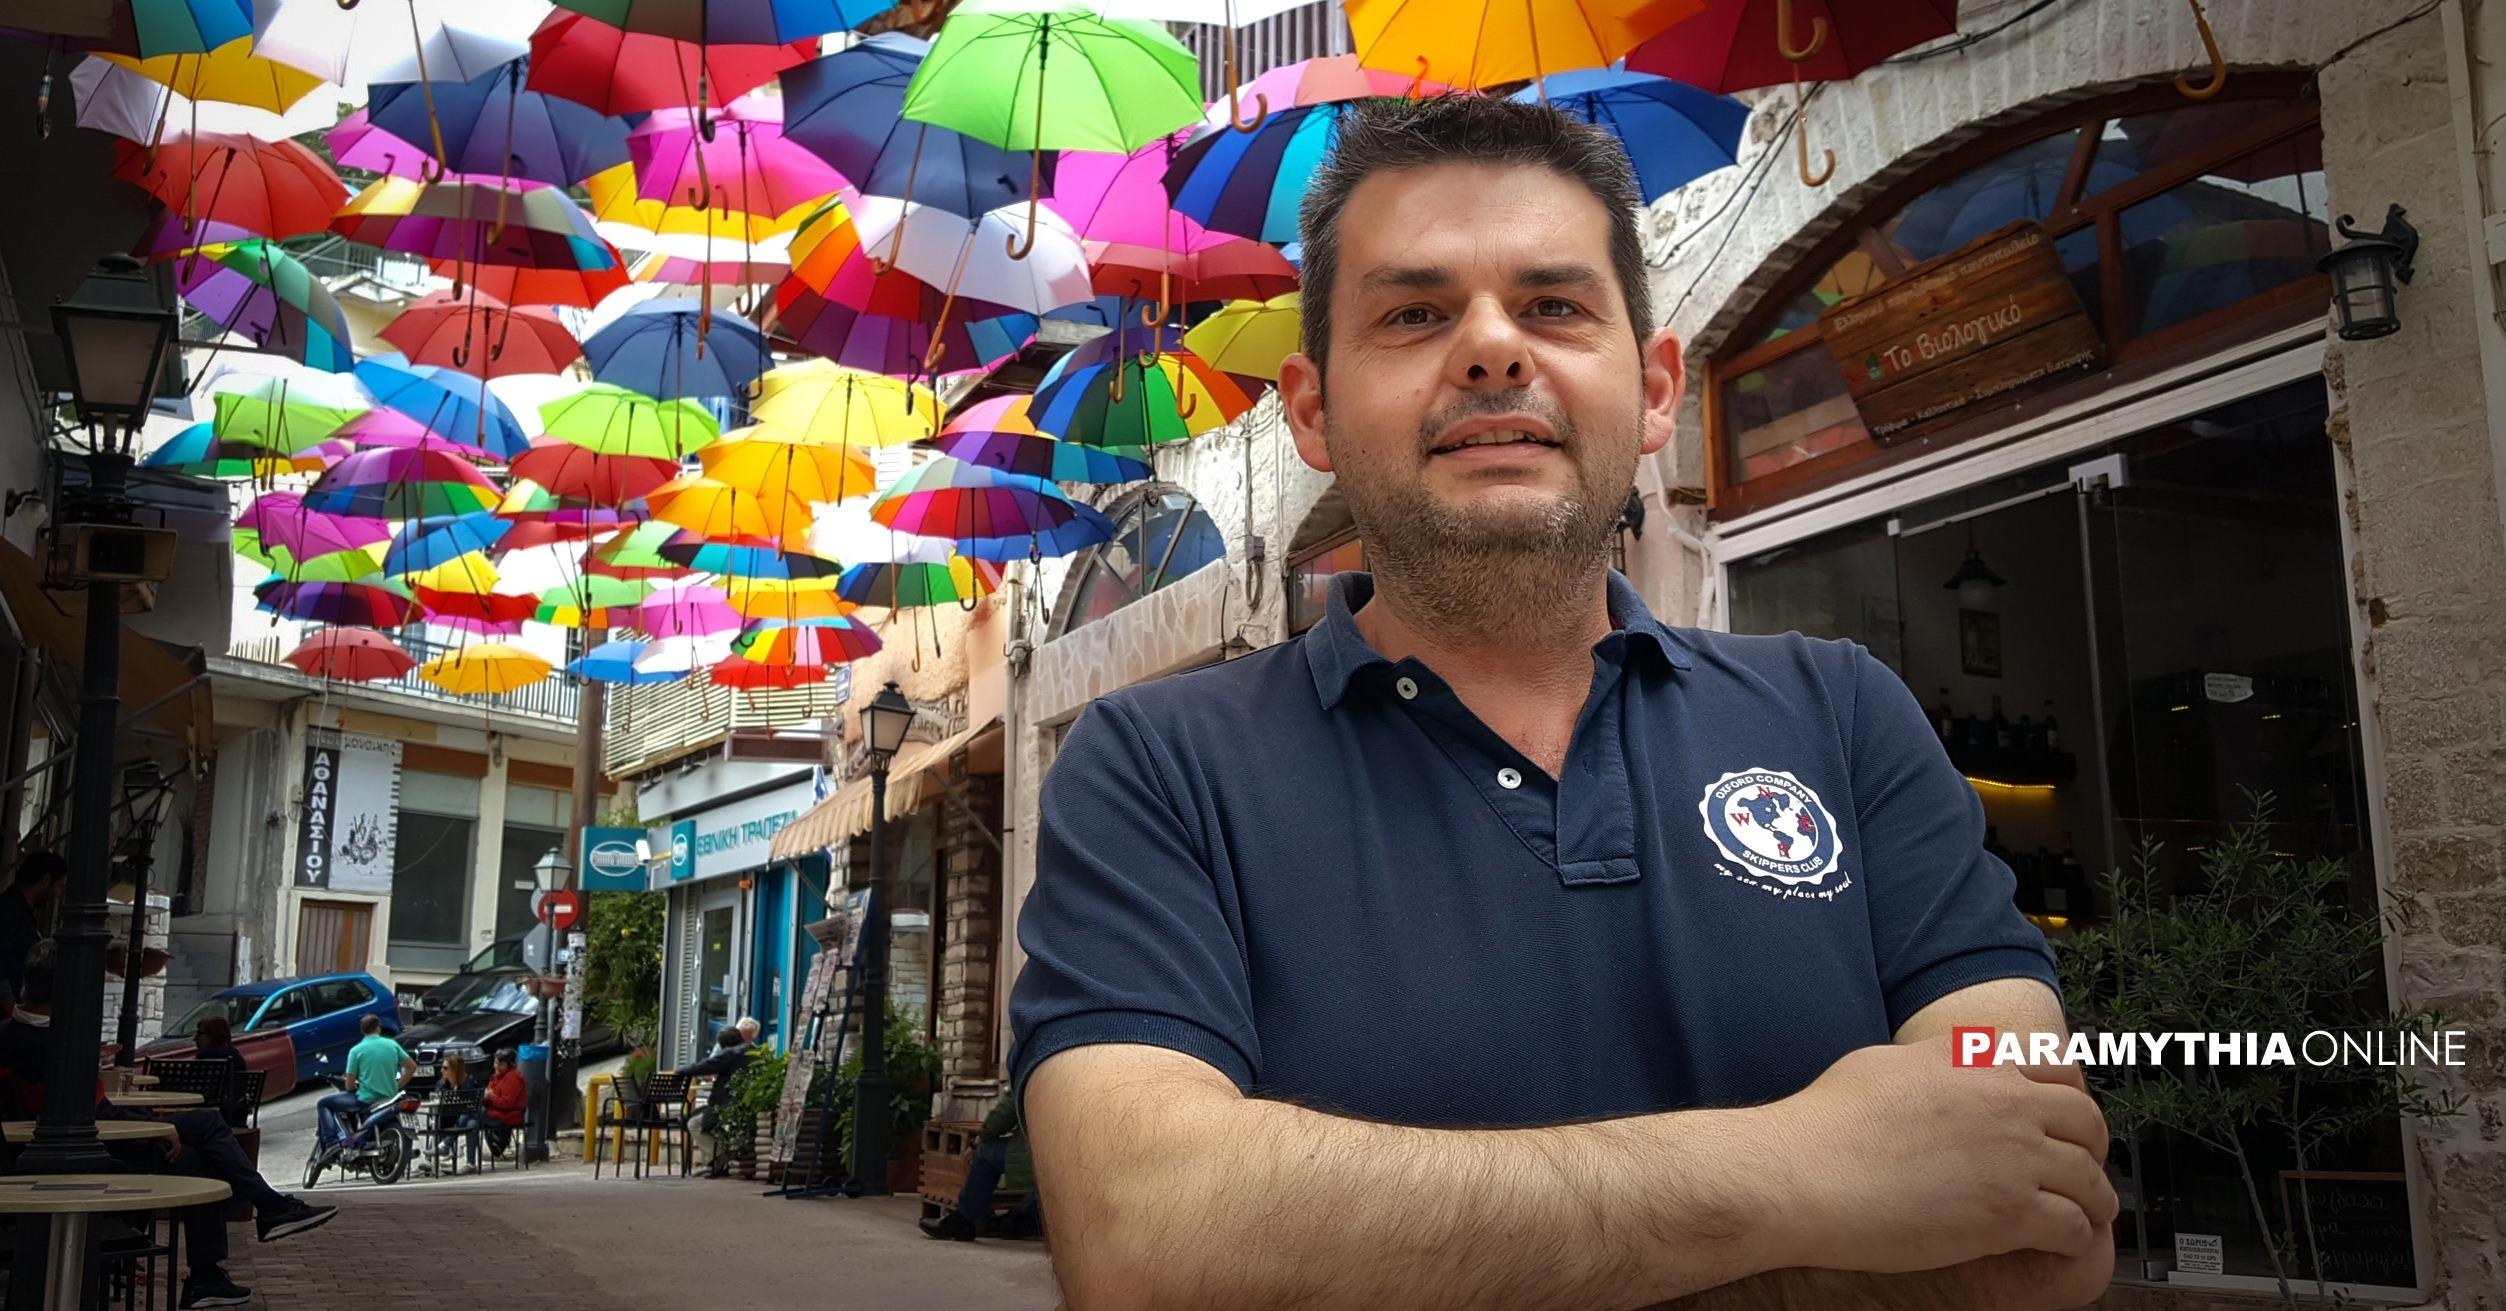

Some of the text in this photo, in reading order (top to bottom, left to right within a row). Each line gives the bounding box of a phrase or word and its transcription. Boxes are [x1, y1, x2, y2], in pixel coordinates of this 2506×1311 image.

[1884, 295, 2022, 372] Το Βιολογικό
[1716, 775, 1813, 803] OXFORD COMPANY
[306, 752, 331, 882] ΑΘΑΝΑΣΙΟΥ
[1730, 813, 1750, 827] W
[697, 826, 738, 856] ΕΘΝΙΚΗ
[1743, 850, 1824, 874] SKIPPERS CLUB
